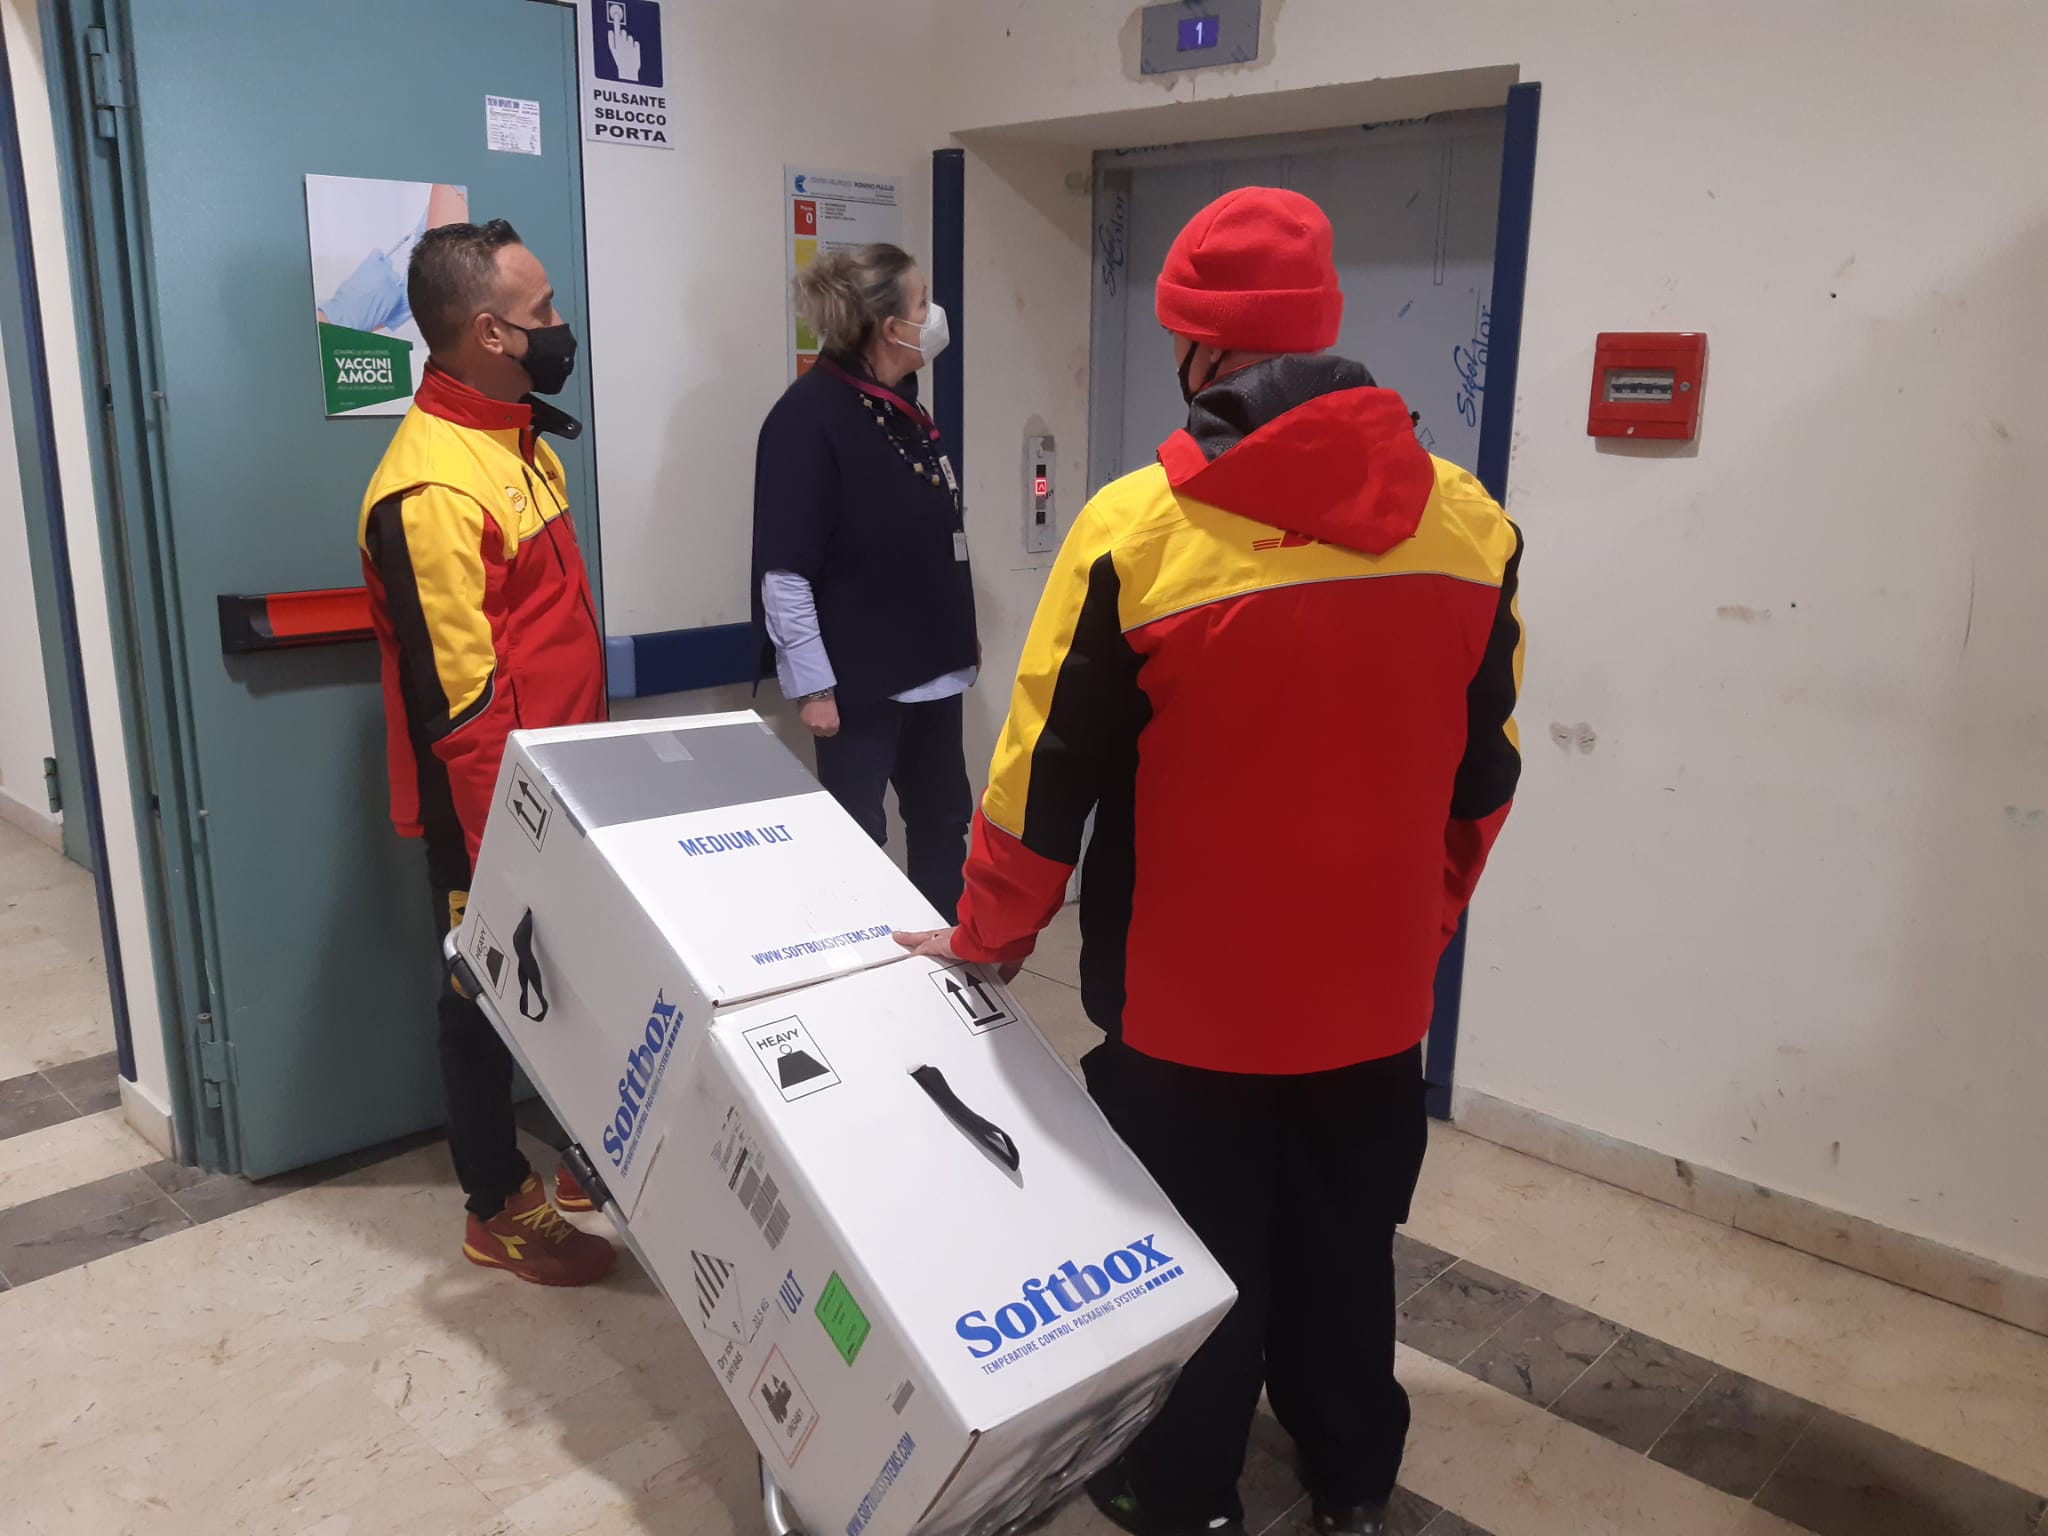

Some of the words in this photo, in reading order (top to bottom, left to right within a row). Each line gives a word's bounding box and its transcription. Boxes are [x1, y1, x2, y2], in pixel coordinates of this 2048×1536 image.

[1195, 21, 1204, 46] 1
[593, 89, 667, 109] PULSANTE
[594, 107, 667, 126] SBLOCCO
[594, 123, 668, 143] PORTA
[334, 357, 392, 370] VACCINI
[336, 369, 394, 383] AMOCI
[678, 829, 761, 857] MEDIUM
[757, 824, 794, 844] ULT
[751, 924, 893, 966] WWW.SOFTBOXSYSTEMS.COM
[756, 1028, 799, 1050] HEAVY
[602, 987, 677, 1168] Softbox
[644, 1075, 661, 1112] PACKG
[779, 1268, 805, 1314] ULT
[955, 1233, 1175, 1359] Softbox
[981, 1340, 1039, 1375] TEMPERATURE
[1037, 1324, 1074, 1347] CONTROL
[1072, 1302, 1116, 1329] PACKAGING
[1113, 1284, 1148, 1308] SYSTEMS
[846, 1431, 917, 1536] WWW.SOFTSYSTEMS.COM
